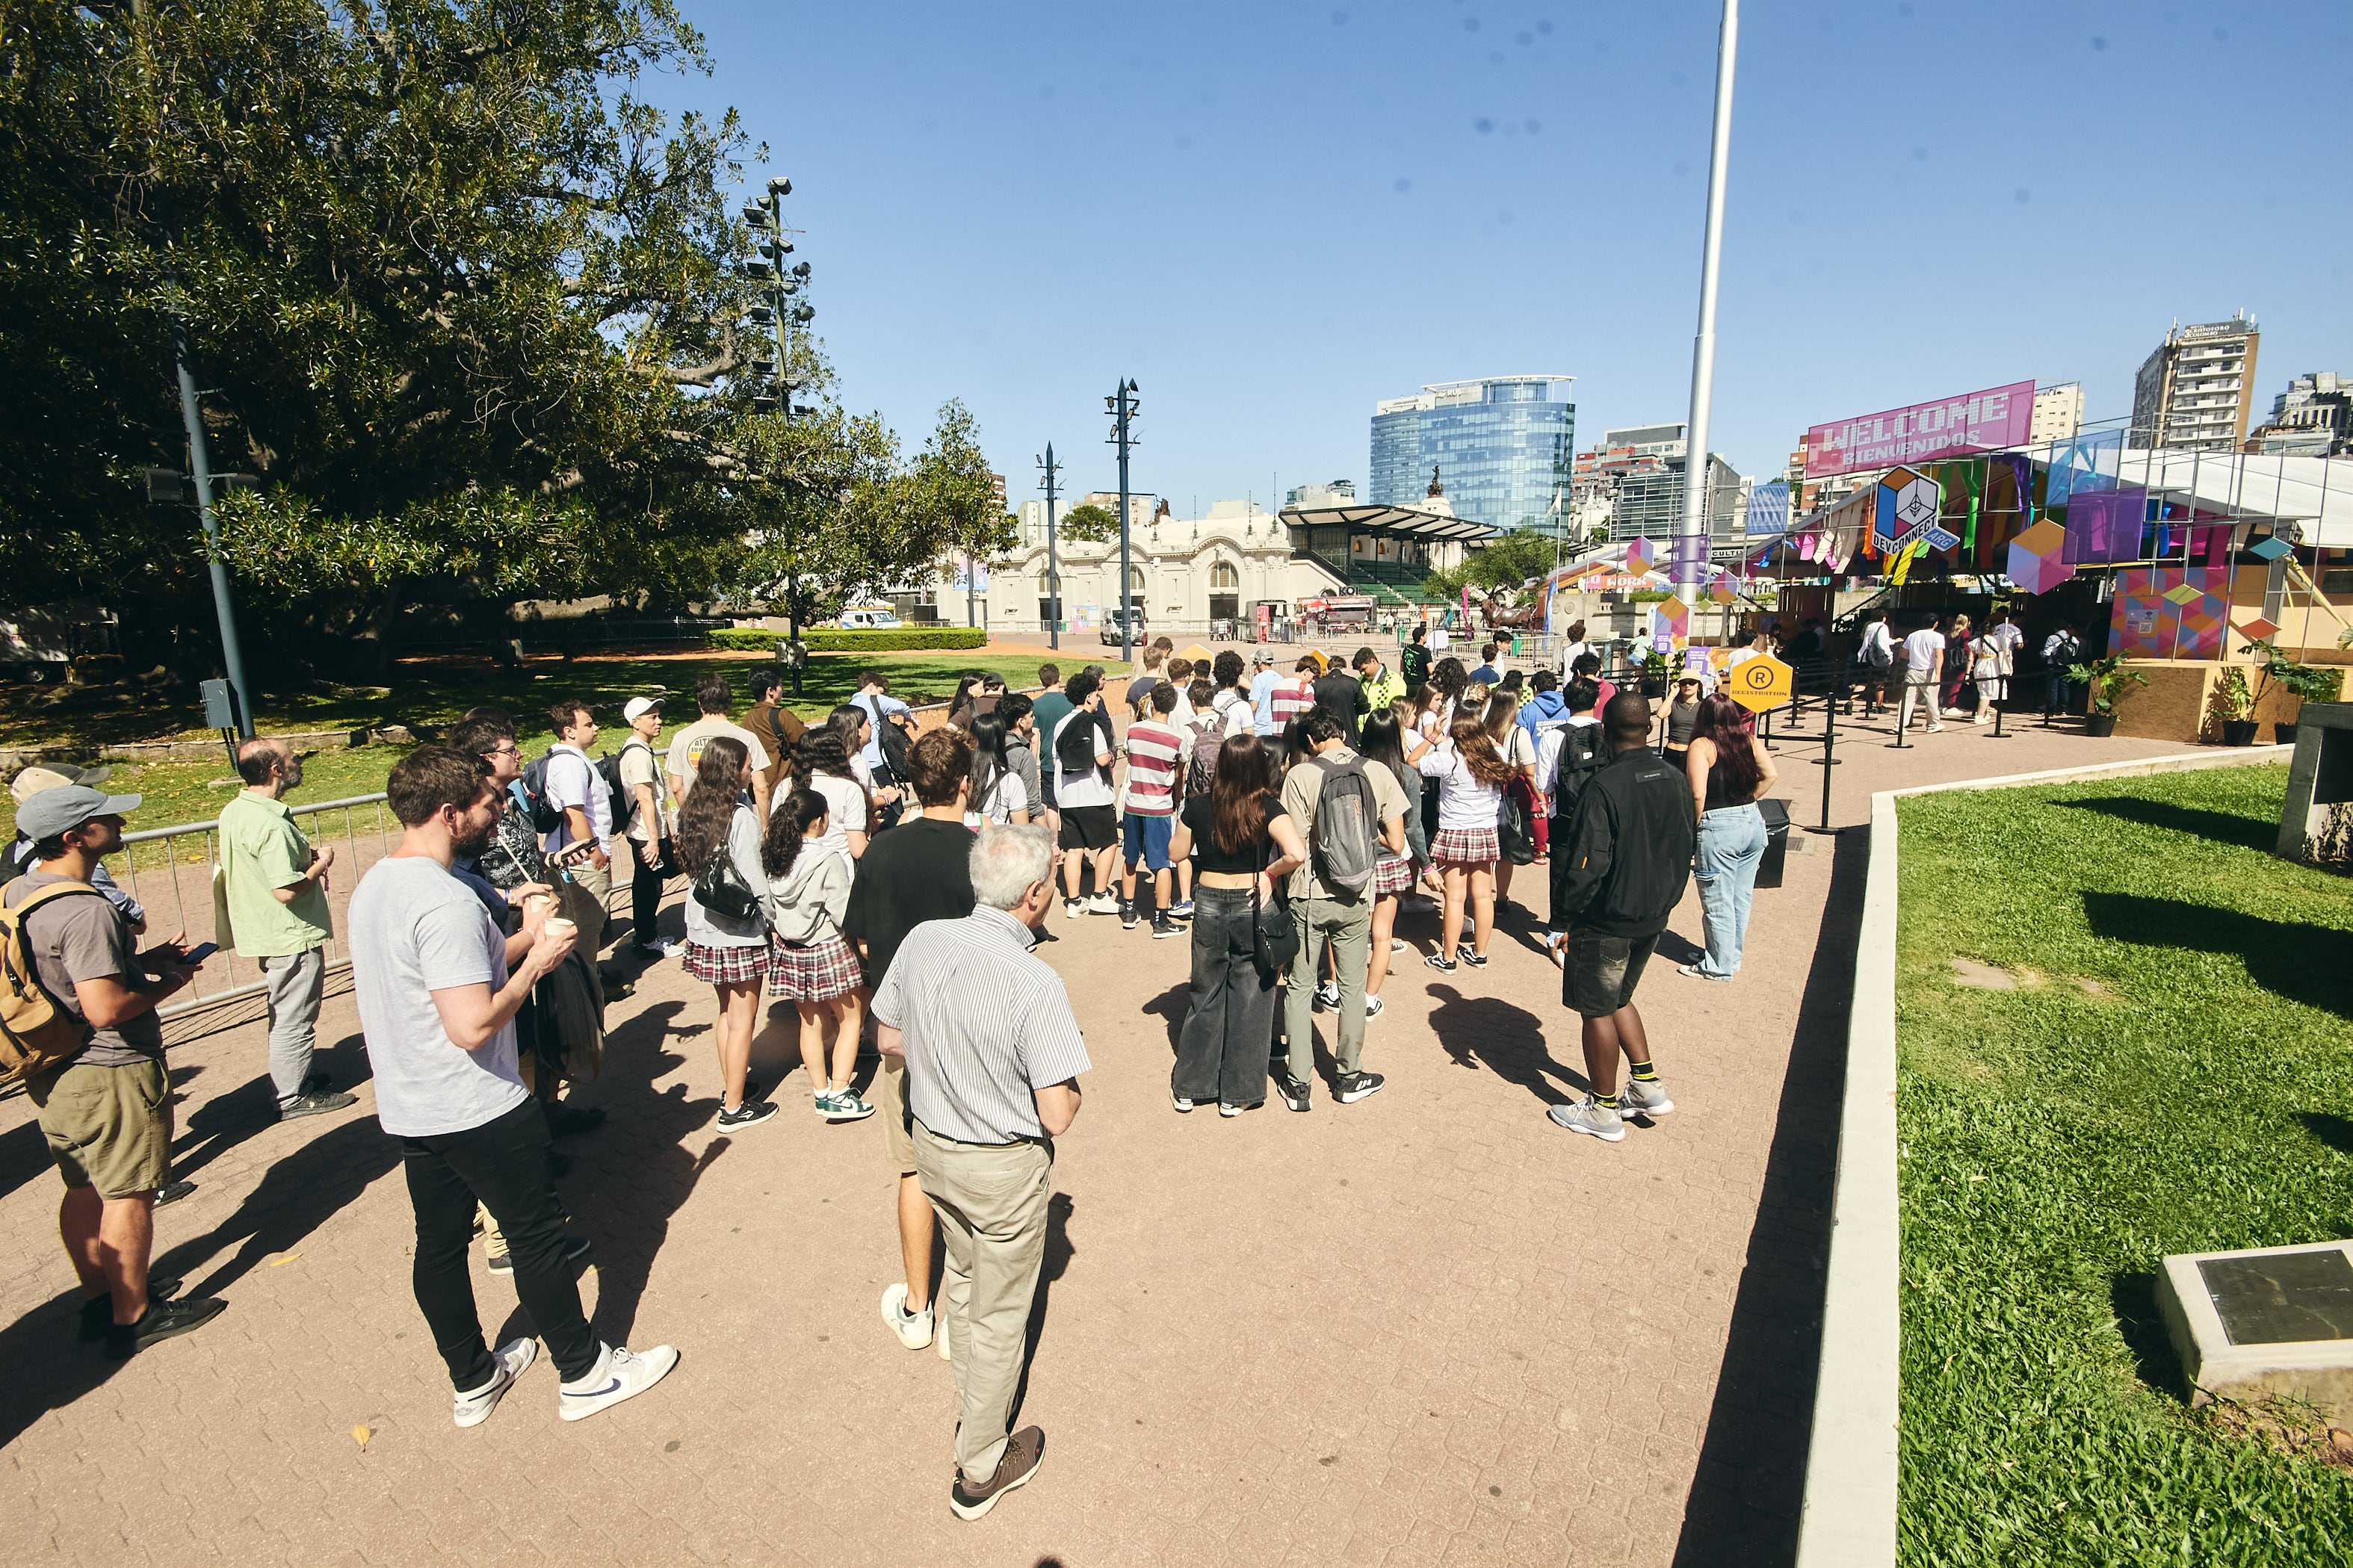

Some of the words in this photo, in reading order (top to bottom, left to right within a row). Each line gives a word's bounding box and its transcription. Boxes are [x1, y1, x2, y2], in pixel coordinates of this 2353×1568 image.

[1823, 391, 2009, 452] WELCOME
[1873, 515, 1937, 554] DEVCONNECT
[1926, 531, 1952, 547] ARG
[1607, 577, 1648, 586] WORK
